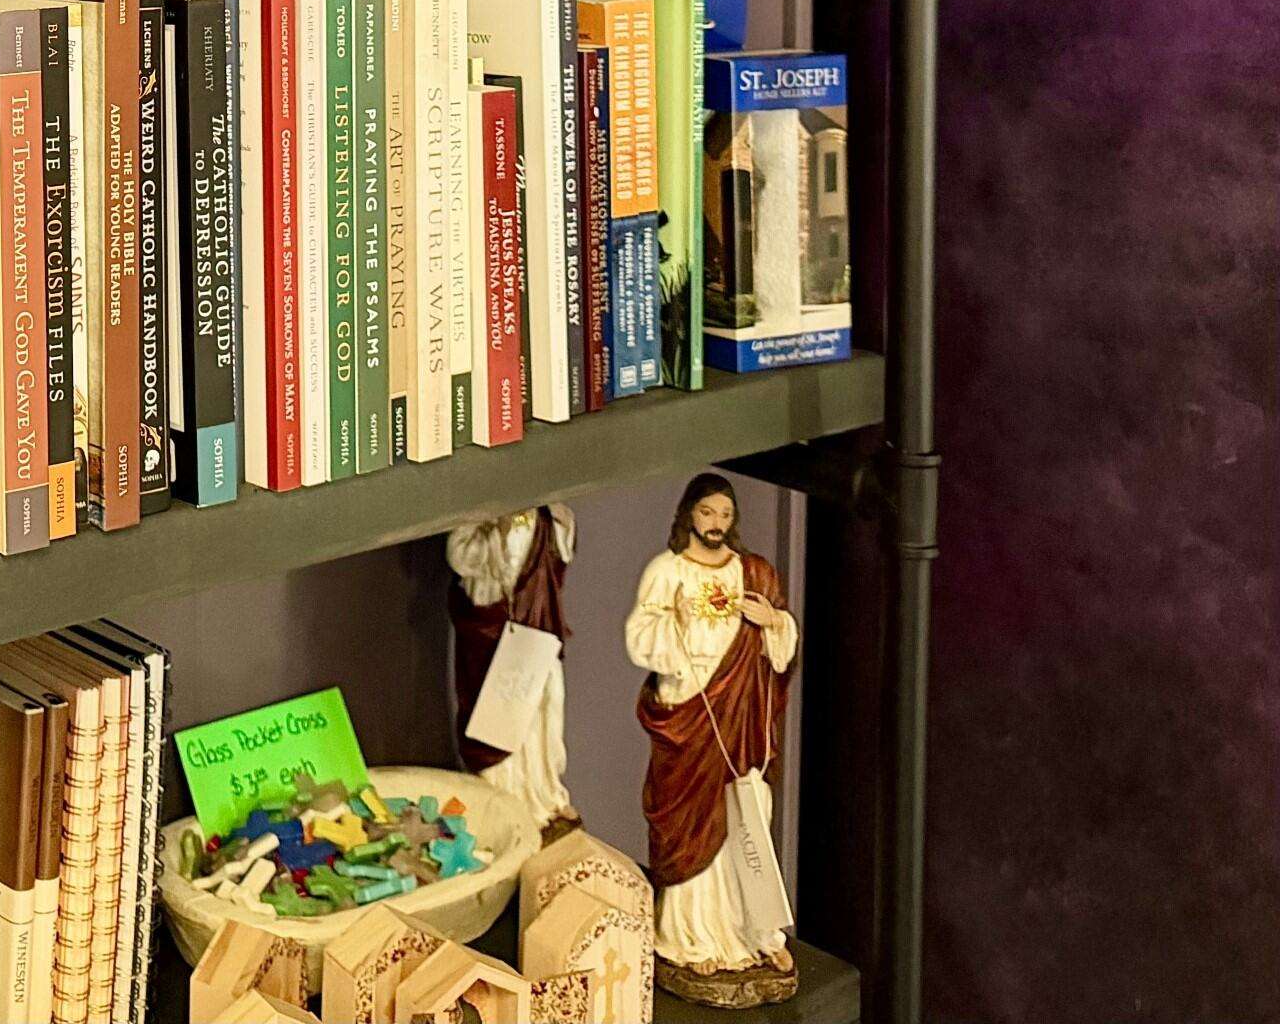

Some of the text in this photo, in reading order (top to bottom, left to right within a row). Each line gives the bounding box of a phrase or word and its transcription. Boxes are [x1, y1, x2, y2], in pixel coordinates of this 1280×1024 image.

[47, 23, 58, 68] BLAI
[204, 26, 213, 92] KHERIATY
[632, 11, 652, 197] THE KINGDOM UNLEASHED
[740, 67, 840, 91] ST. JOSEPH
[45, 116, 61, 172] THE
[335, 6, 351, 382] TOMBO LISTENING FOR GOD
[495, 118, 505, 180] TASSONE
[563, 64, 582, 327] THE POWER OF THE ROSARY
[12, 26, 35, 480] Bennett THE TEMPERAMENT GOD GAVE YOU
[110, 104, 121, 326] ADAPTED FOR YOUNG READERS
[123, 150, 134, 277] THE HOLY BIBLE
[141, 20, 158, 420] LICHENS WEIRD CATHOLIC HANDBOOK
[195, 150, 212, 337] TO DEPRESSION
[211, 114, 230, 368] The CATHOLIC GUIDE
[427, 87, 444, 374] SCRIPTURE WARS
[488, 197, 503, 352] TO FAUSTINA AND YOU
[498, 207, 516, 336] JESUS SPEAKS
[49, 326, 65, 403] FILES
[501, 378, 511, 431] SOPHIA
[214, 438, 223, 488] SOPHIA
[186, 712, 328, 768] Glass Pocket Cross
[14, 930, 28, 1004] WINESKIN
